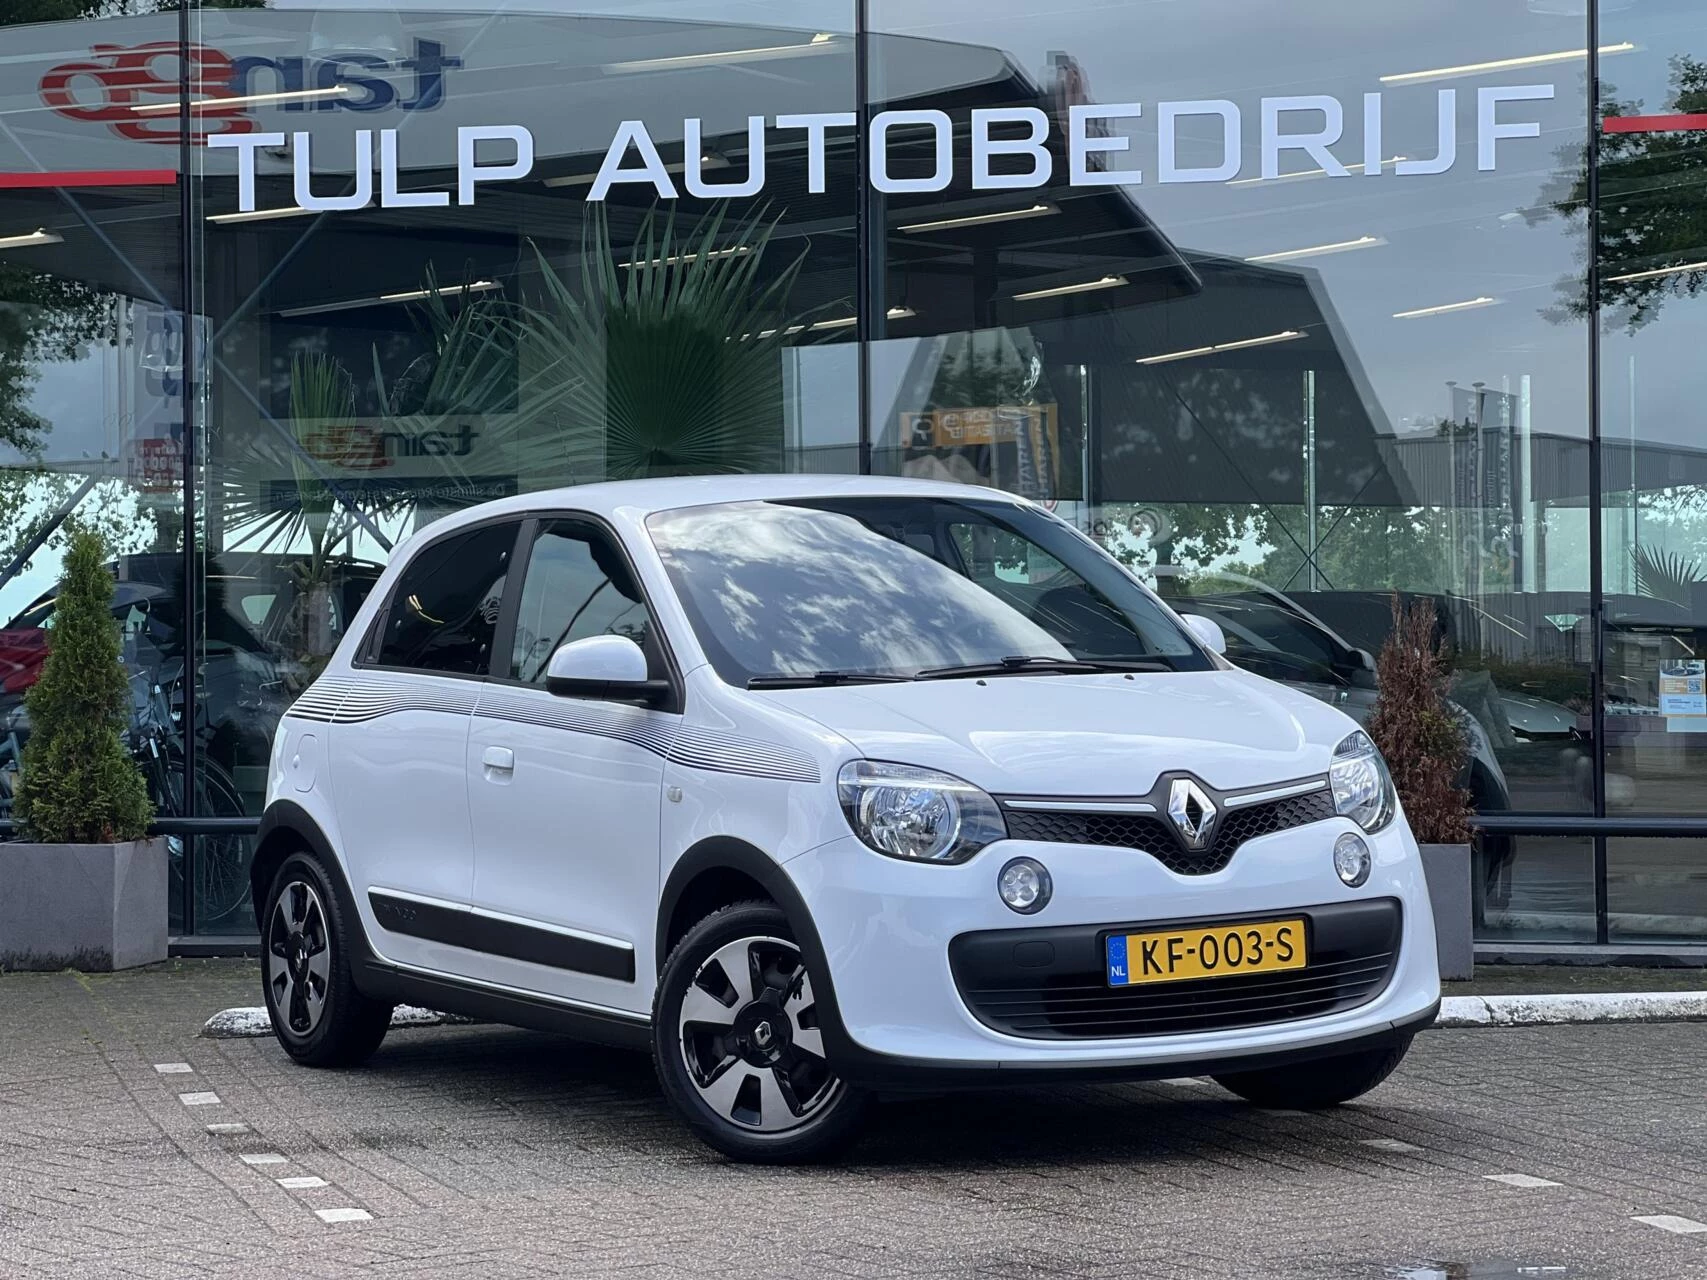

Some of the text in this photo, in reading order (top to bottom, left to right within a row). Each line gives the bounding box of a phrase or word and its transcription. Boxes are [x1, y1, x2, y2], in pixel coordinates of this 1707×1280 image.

[207, 85, 1554, 212] TULP AUTOBEDRIJF
[1111, 966, 1125, 977] NL
[1141, 927, 1294, 975] KF-003-S
